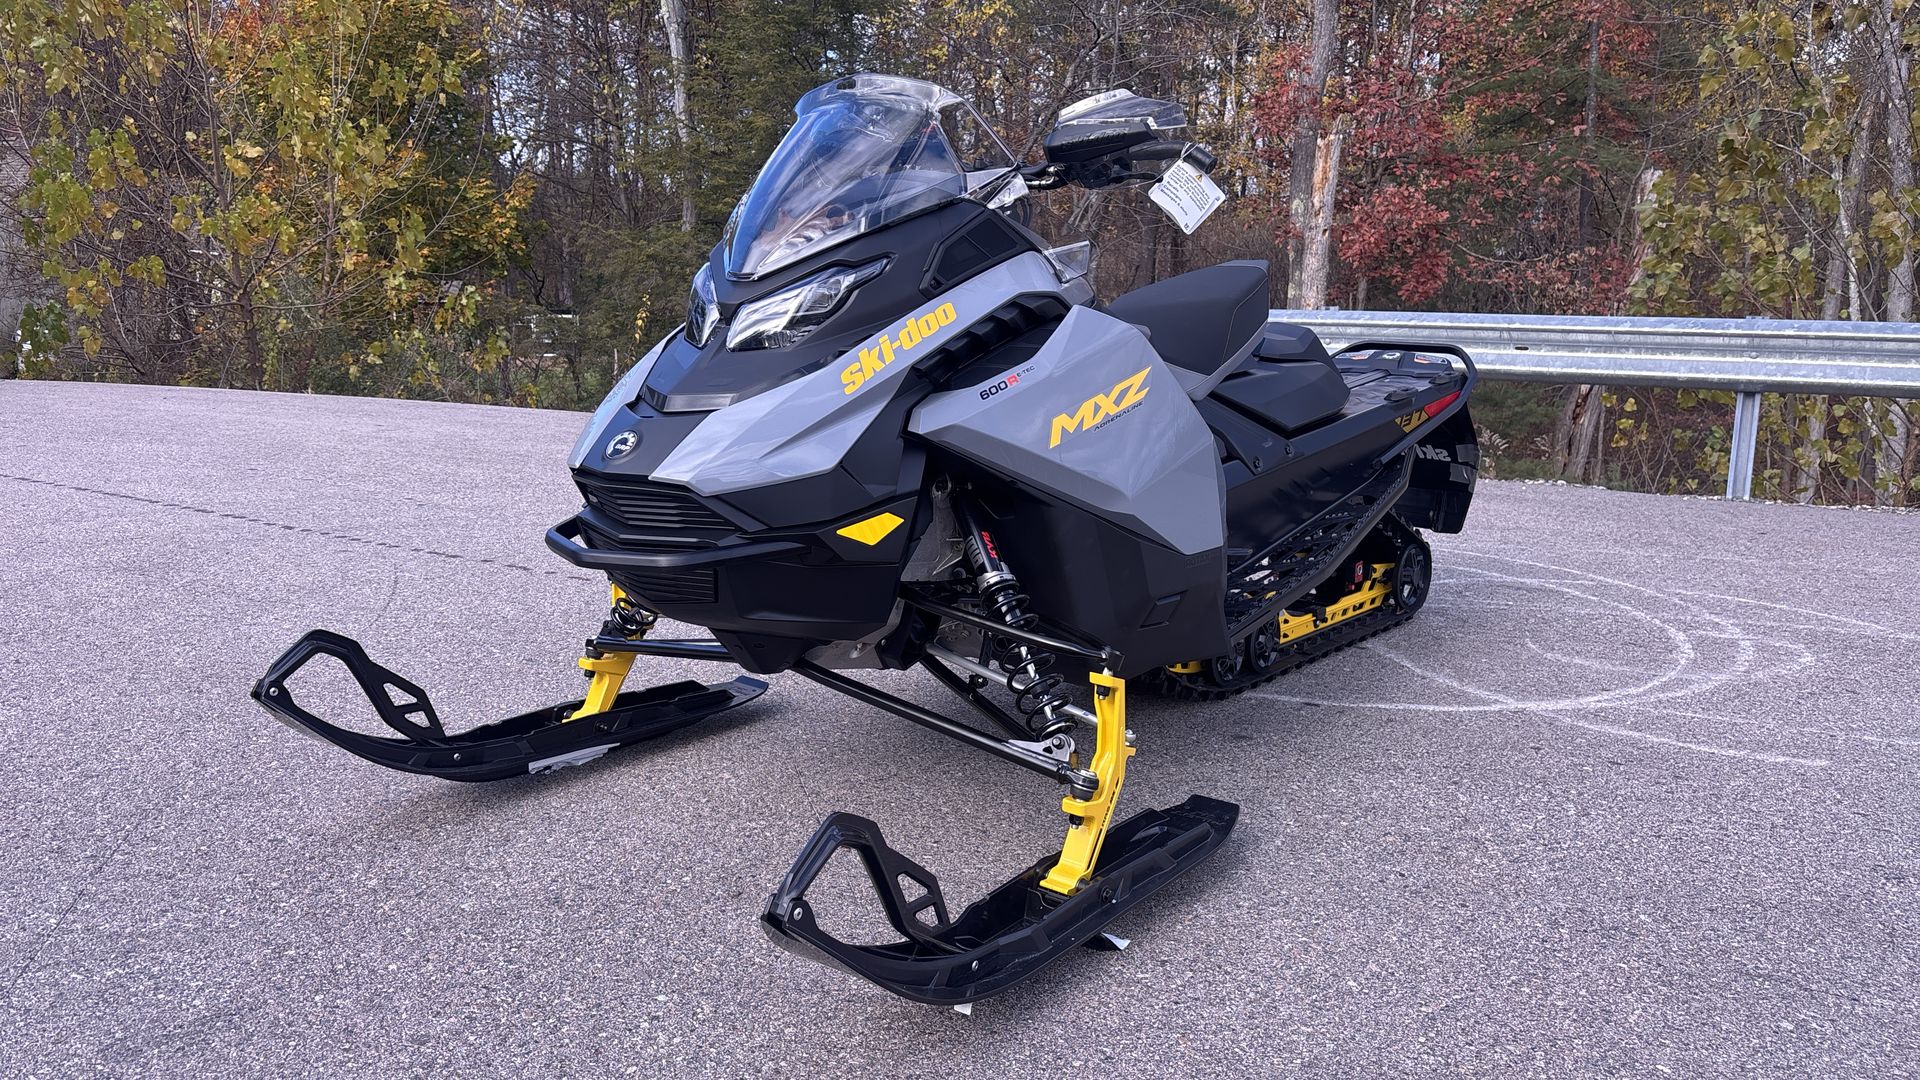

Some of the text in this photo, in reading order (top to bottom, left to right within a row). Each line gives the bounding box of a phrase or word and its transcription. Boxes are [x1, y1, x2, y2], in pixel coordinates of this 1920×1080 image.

[840, 302, 957, 395] ski-doo
[1049, 364, 1152, 449] MXZ
[1093, 400, 1144, 432] ADRENALINE
